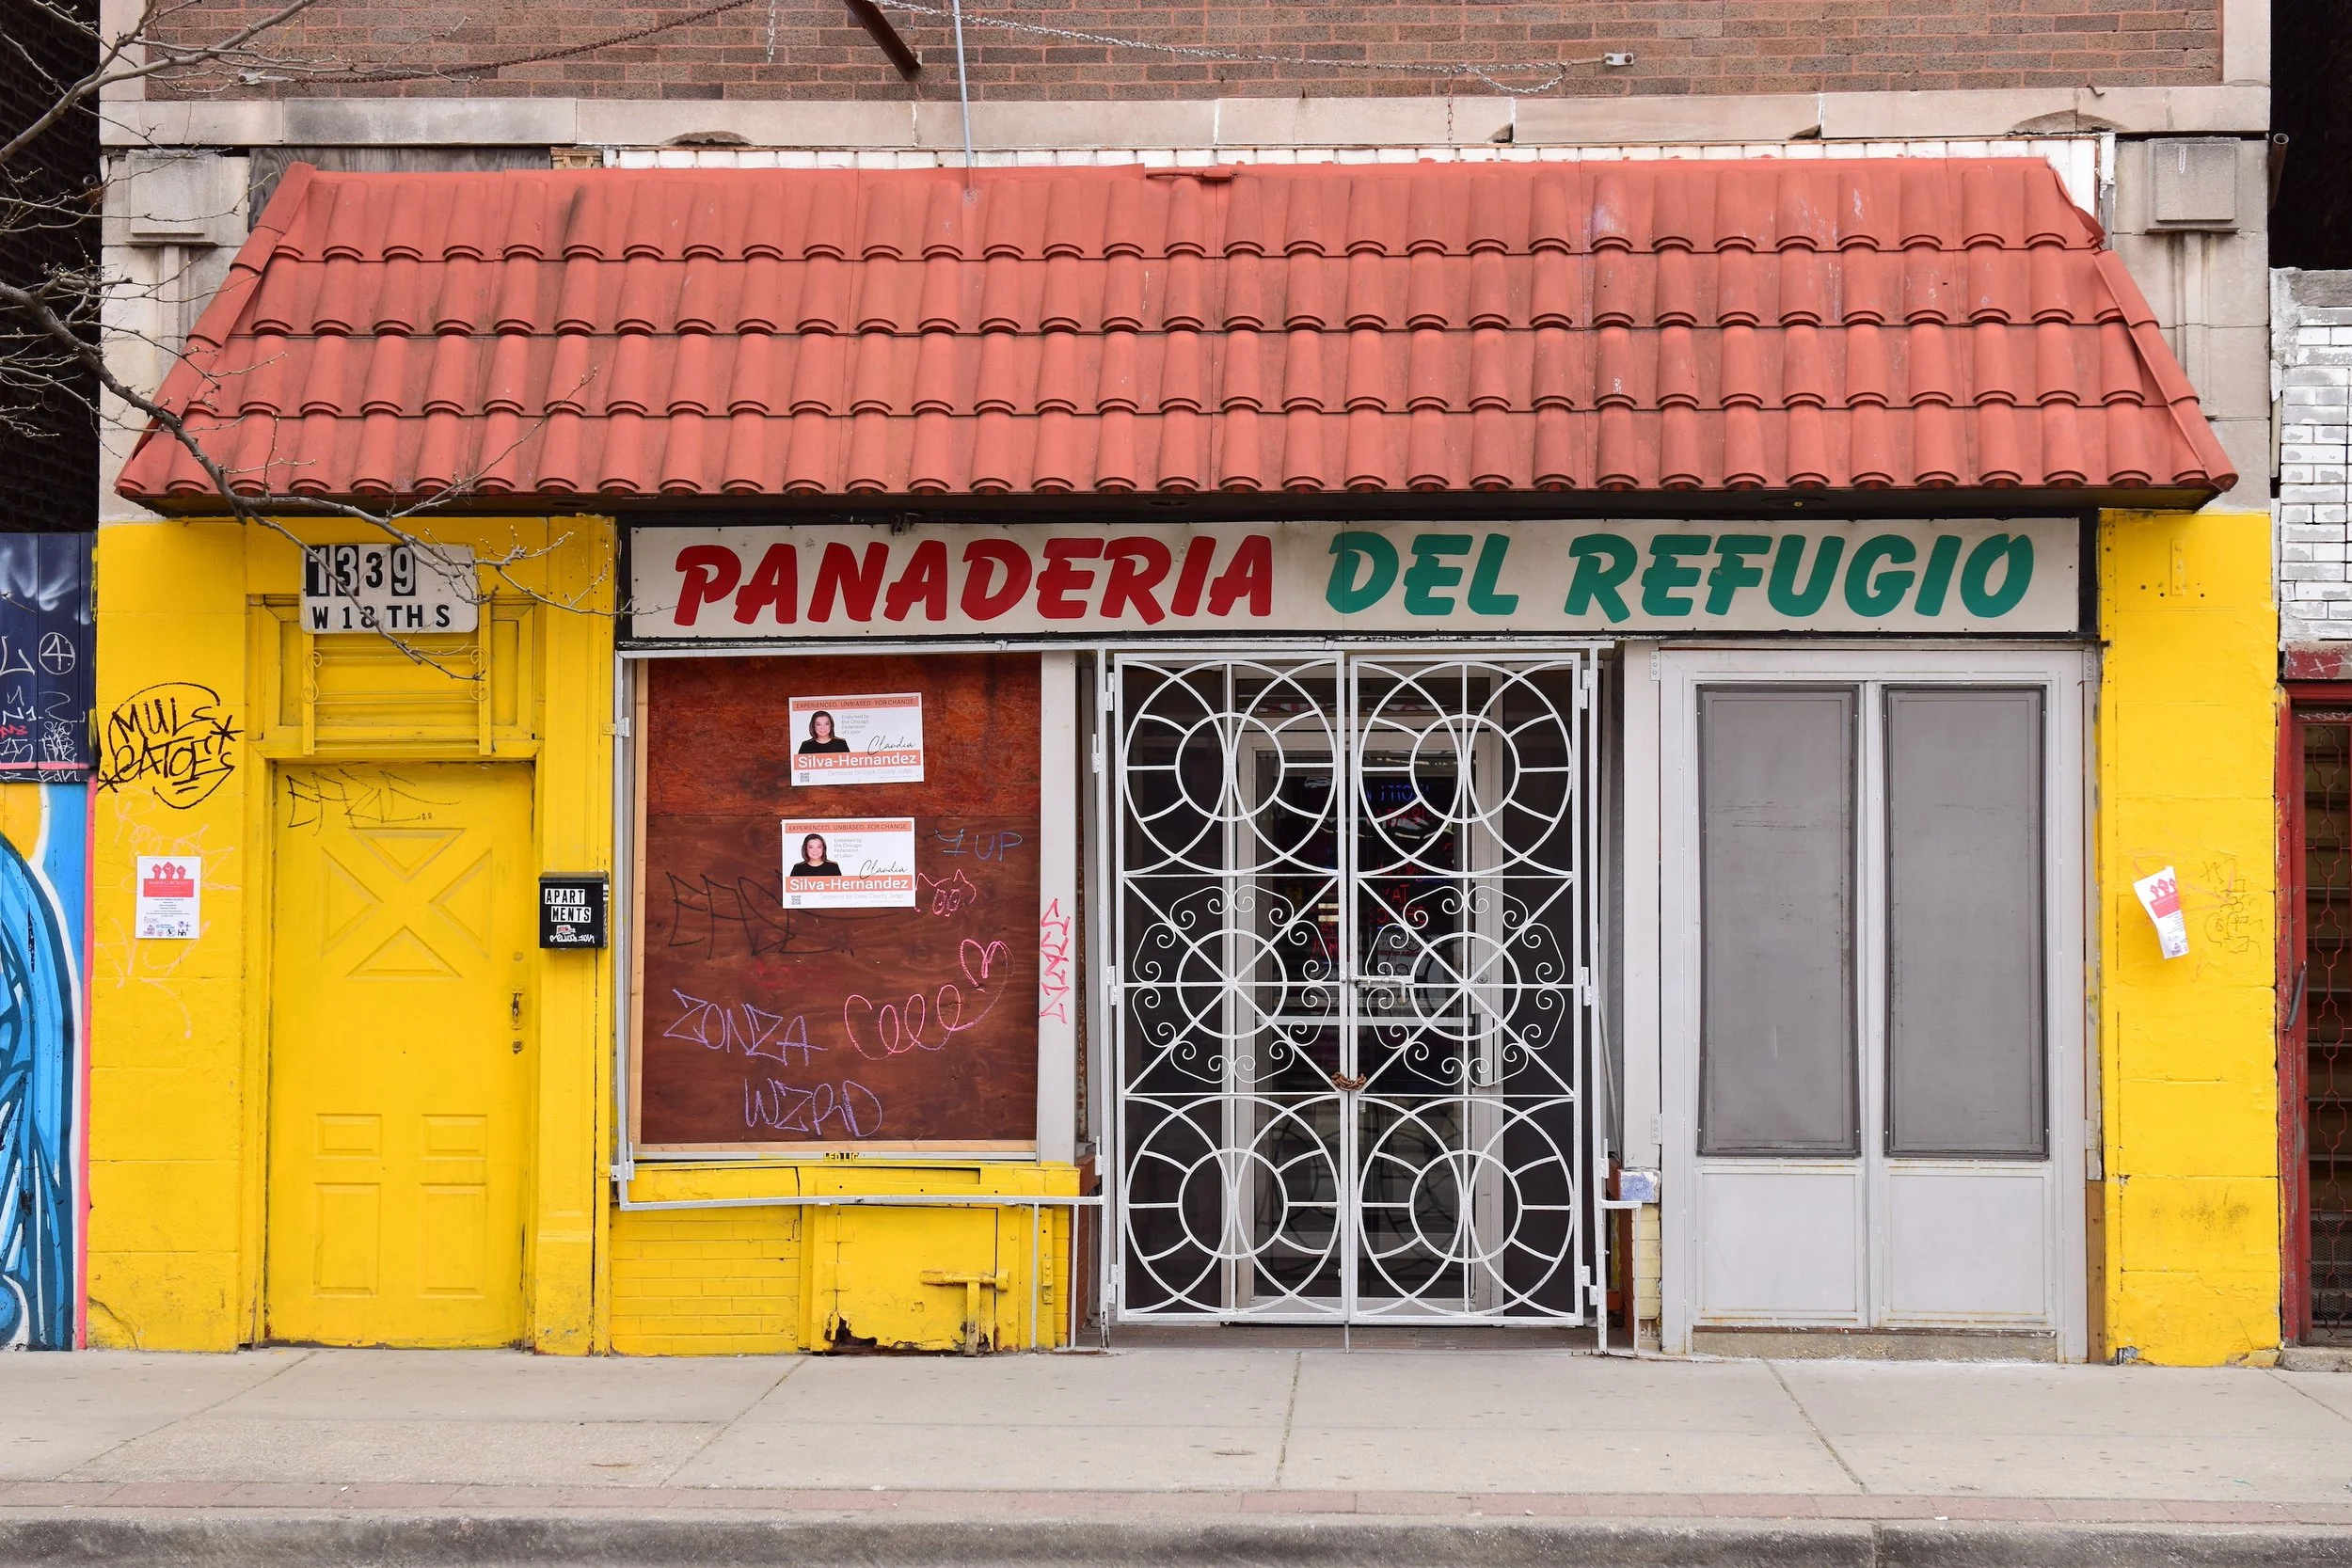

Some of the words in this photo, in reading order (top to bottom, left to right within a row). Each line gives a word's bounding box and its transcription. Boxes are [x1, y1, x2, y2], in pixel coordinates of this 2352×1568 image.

[309, 546, 416, 594] 1339
[674, 534, 1272, 626] PANADERIA
[1325, 531, 1519, 616] DEL
[1564, 532, 2035, 624] REFUGIO
[312, 606, 328, 629] W
[435, 604, 451, 627] S
[798, 752, 917, 768] Silva-Hernandez
[789, 877, 909, 891] Silva-Hernandez
[546, 890, 583, 903] APART
[552, 908, 590, 921] MENTS
